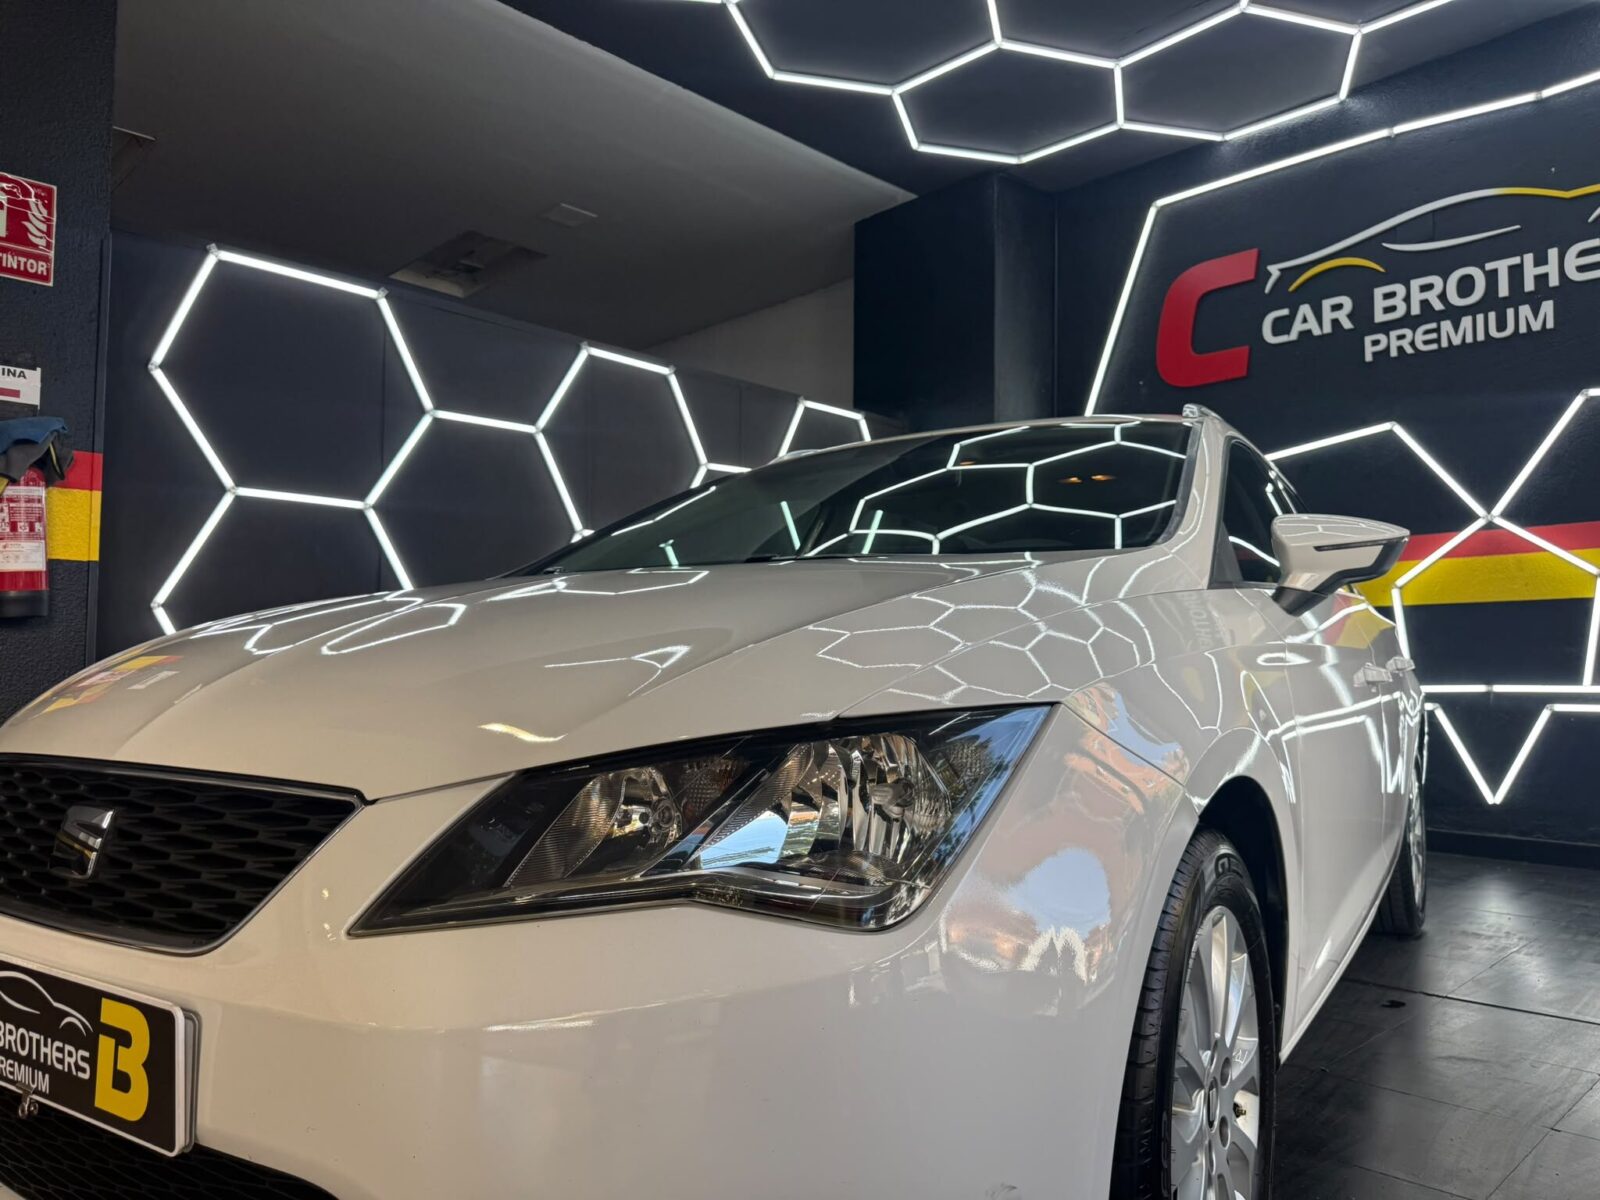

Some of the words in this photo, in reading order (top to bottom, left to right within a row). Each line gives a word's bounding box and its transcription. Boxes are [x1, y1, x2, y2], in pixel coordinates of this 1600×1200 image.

[0, 252, 48, 276] INTOR
[1155, 247, 1259, 388] C
[1261, 295, 1354, 345] CAR
[1363, 299, 1555, 363] PREMIUM
